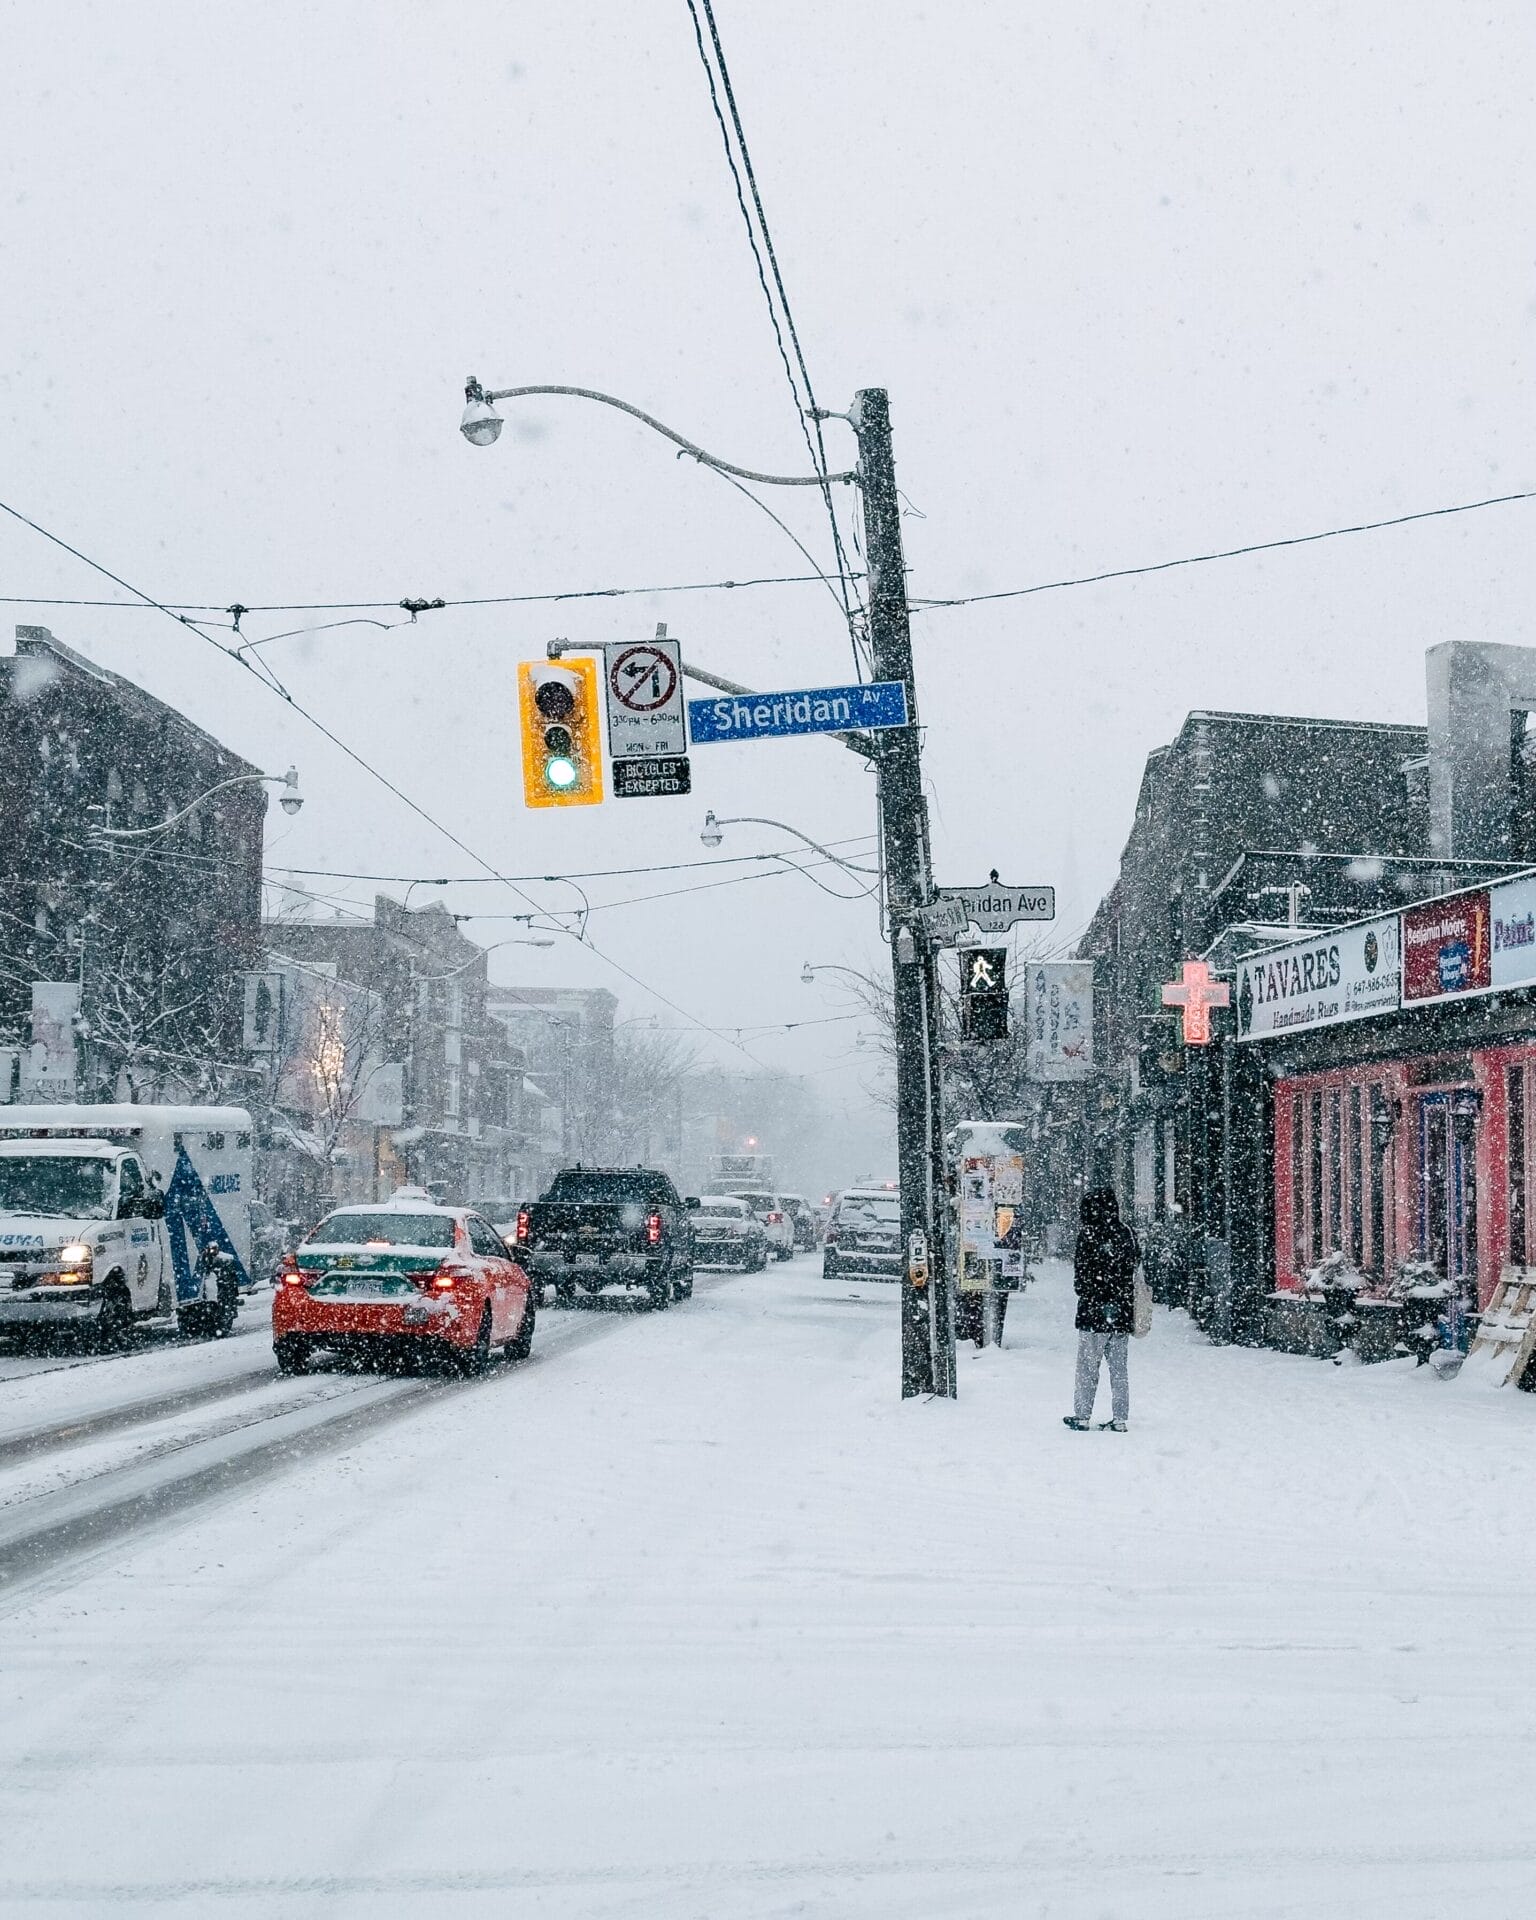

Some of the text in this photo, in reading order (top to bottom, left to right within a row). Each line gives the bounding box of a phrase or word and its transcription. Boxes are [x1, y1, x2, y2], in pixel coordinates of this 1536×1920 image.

[714, 690, 881, 730] Sheridan Av
[655, 741, 669, 751] FRI
[626, 762, 677, 777] BICYCLES
[625, 779, 680, 793] EXCEPTED
[962, 894, 1047, 913] eridan Ave
[1254, 945, 1341, 1005] TAVARES
